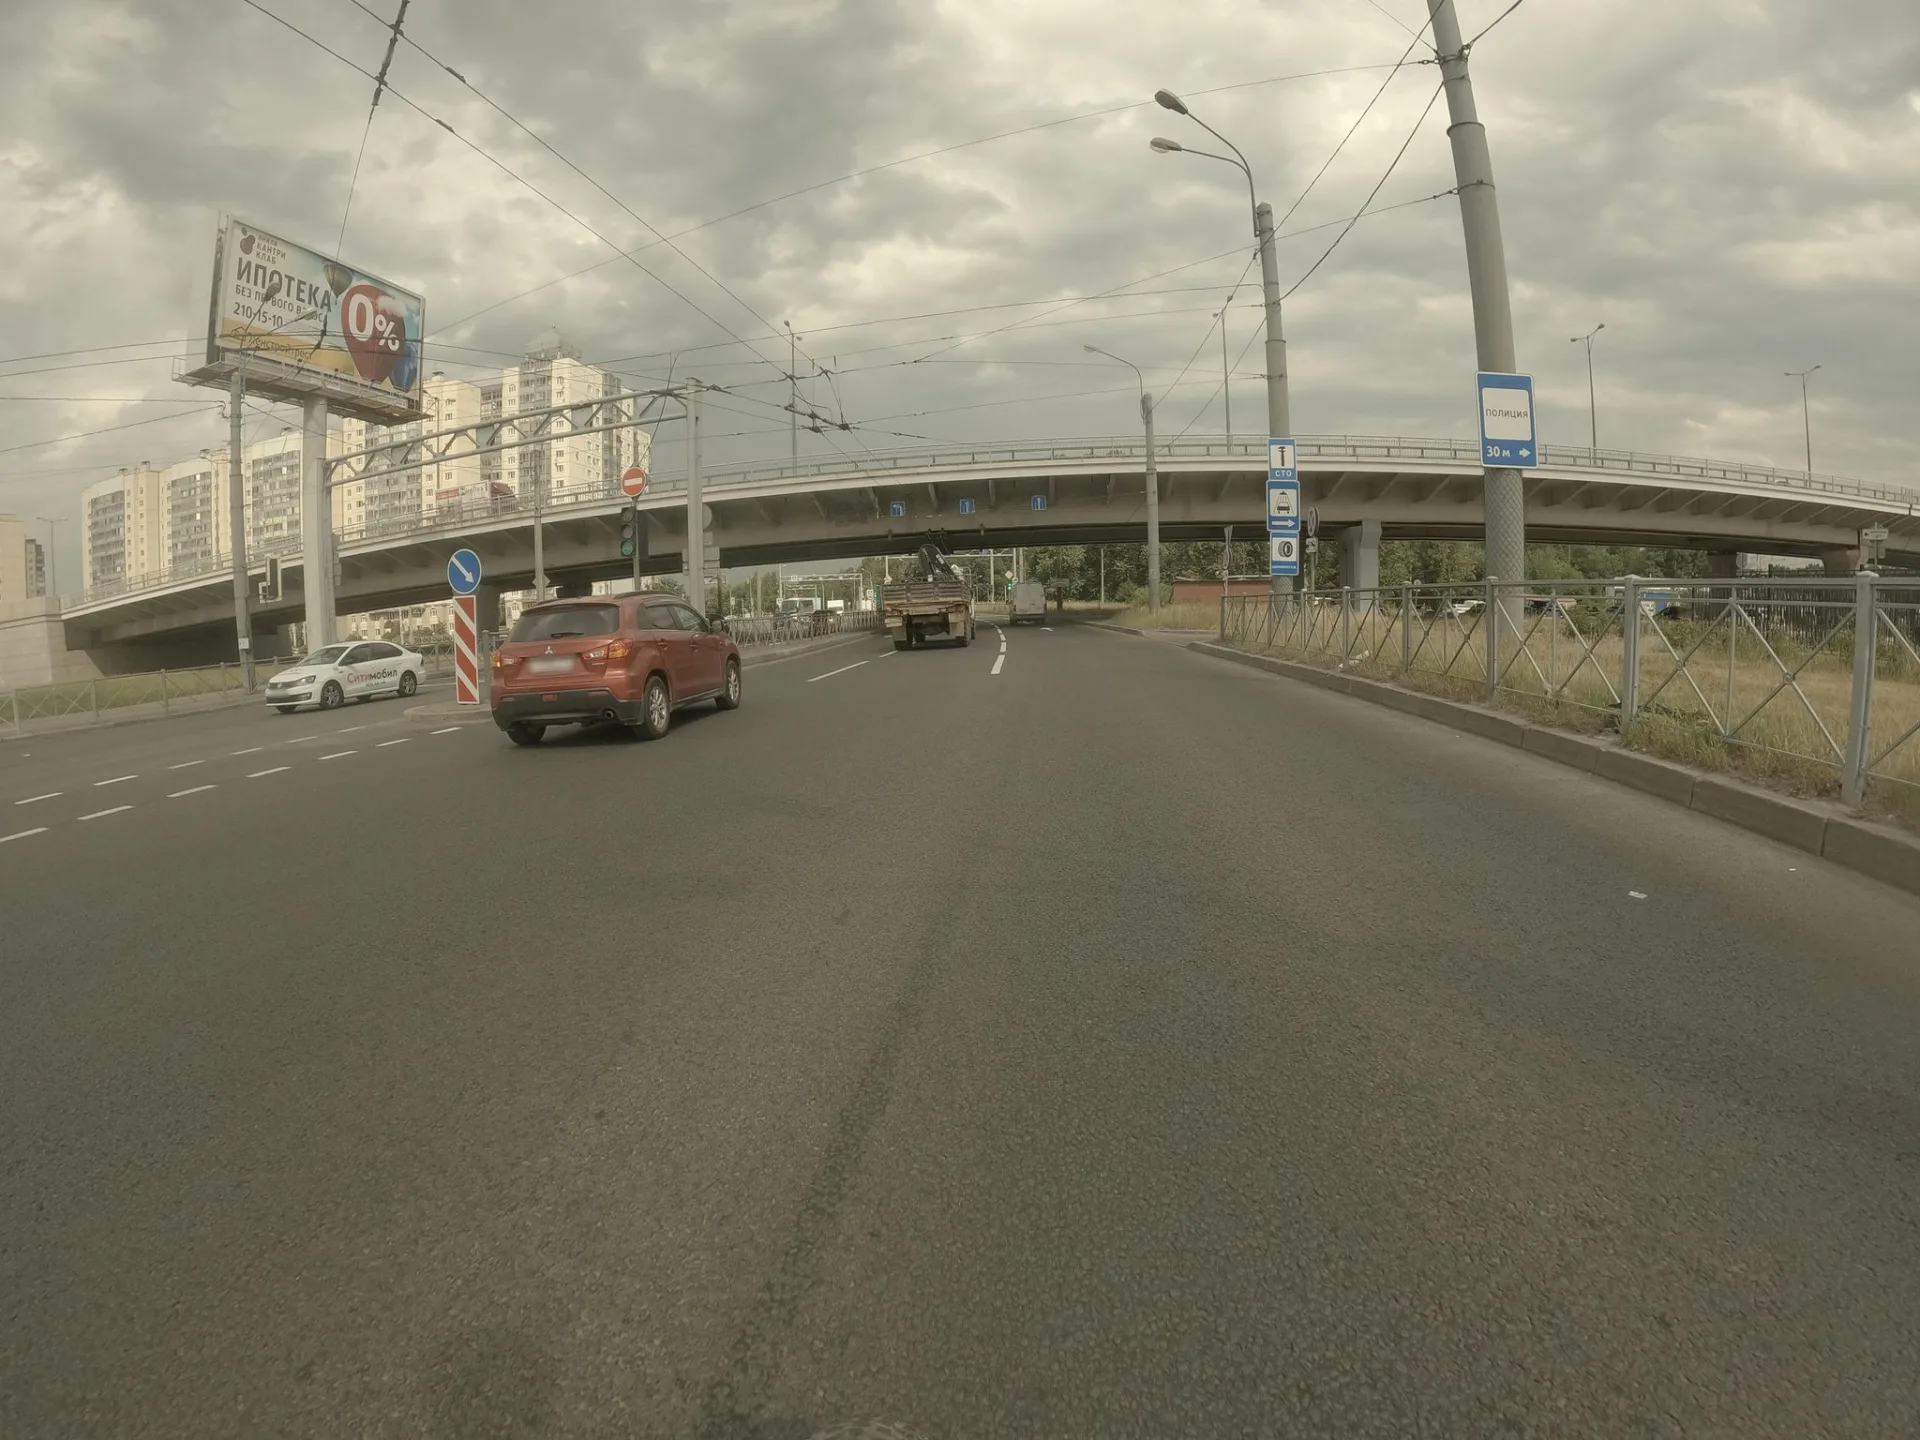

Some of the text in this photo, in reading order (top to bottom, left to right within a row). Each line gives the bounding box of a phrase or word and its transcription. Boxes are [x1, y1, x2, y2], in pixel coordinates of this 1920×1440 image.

[256, 242, 286, 260] КАНТРИ
[256, 251, 277, 264] КЛАБ
[237, 257, 332, 312] ИПОТЕКА
[235, 284, 294, 312] БЕЗ ПЕВОГО
[233, 301, 283, 328] 210-15-10
[348, 293, 400, 352] 0%
[1485, 408, 1529, 419] ПОЛИЦИЯ
[1486, 445, 1500, 457] 30
[1275, 469, 1292, 478] СТО
[347, 668, 398, 684] Ситимобил
